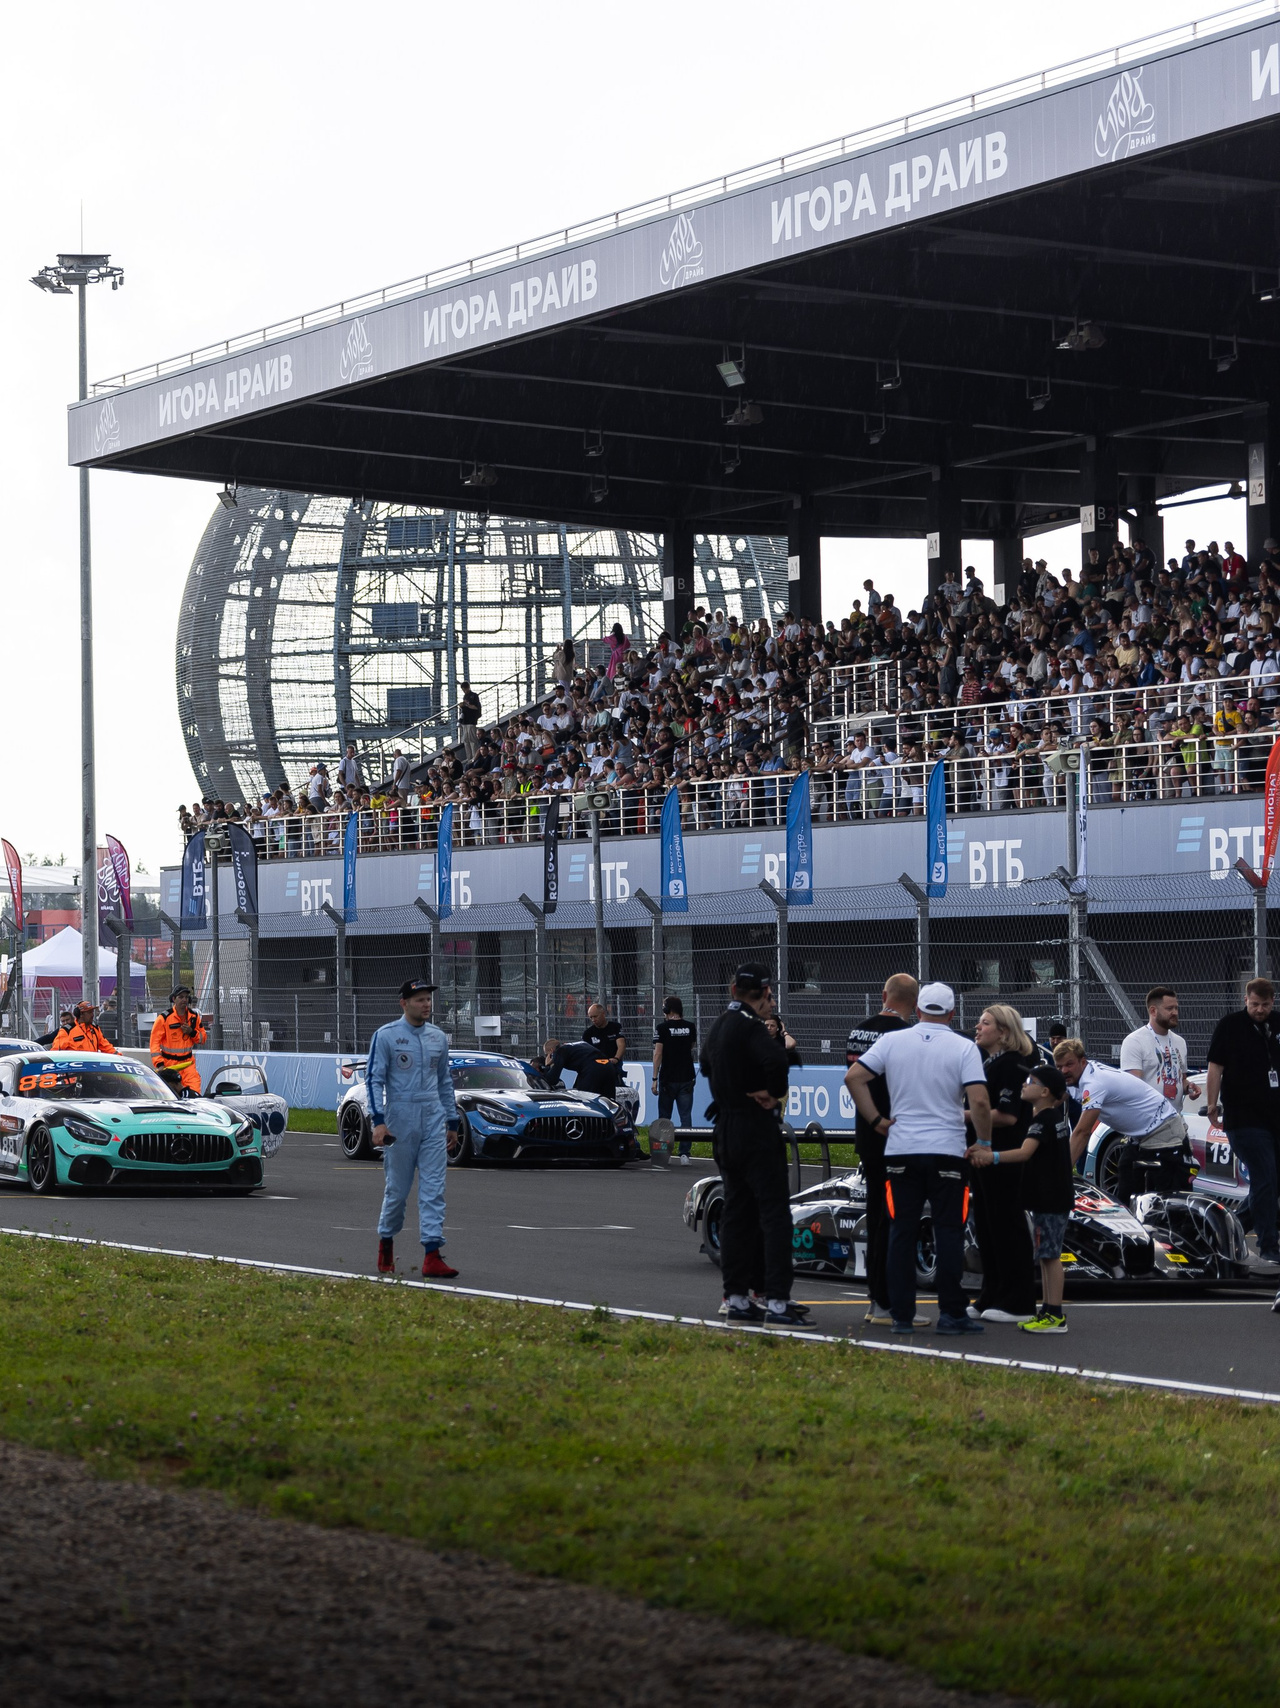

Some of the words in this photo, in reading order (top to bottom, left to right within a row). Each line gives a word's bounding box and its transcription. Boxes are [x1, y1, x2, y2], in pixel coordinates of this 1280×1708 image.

[1130, 132, 1156, 149] ДРАЙВ
[771, 172, 876, 244] ИГОРА
[885, 131, 1008, 217] ДРАЙВ
[424, 290, 502, 347] ИГОРА
[508, 259, 598, 329] ДРАЙВ
[159, 378, 219, 427] ИГОРА
[224, 354, 293, 413] ДРАЙВ
[1251, 482, 1263, 499] A2
[1083, 512, 1093, 526] A1
[928, 539, 938, 553] A1
[764, 853, 787, 893] ВТ
[969, 839, 1025, 890] ВТБ
[192, 861, 203, 897] ВТБ
[301, 878, 333, 916] ВТБ
[436, 870, 472, 910] ТБ
[849, 1029, 885, 1043] SPORTCA
[114, 1063, 144, 1075] ВТБ
[224, 1055, 268, 1084] iBOX
[499, 1059, 524, 1070] ВТБ
[19, 1073, 58, 1092] 88
[785, 1085, 830, 1118] ВТО
[2, 1137, 15, 1156] 88
[810, 1222, 821, 1234] 42
[839, 1218, 856, 1229] INN
